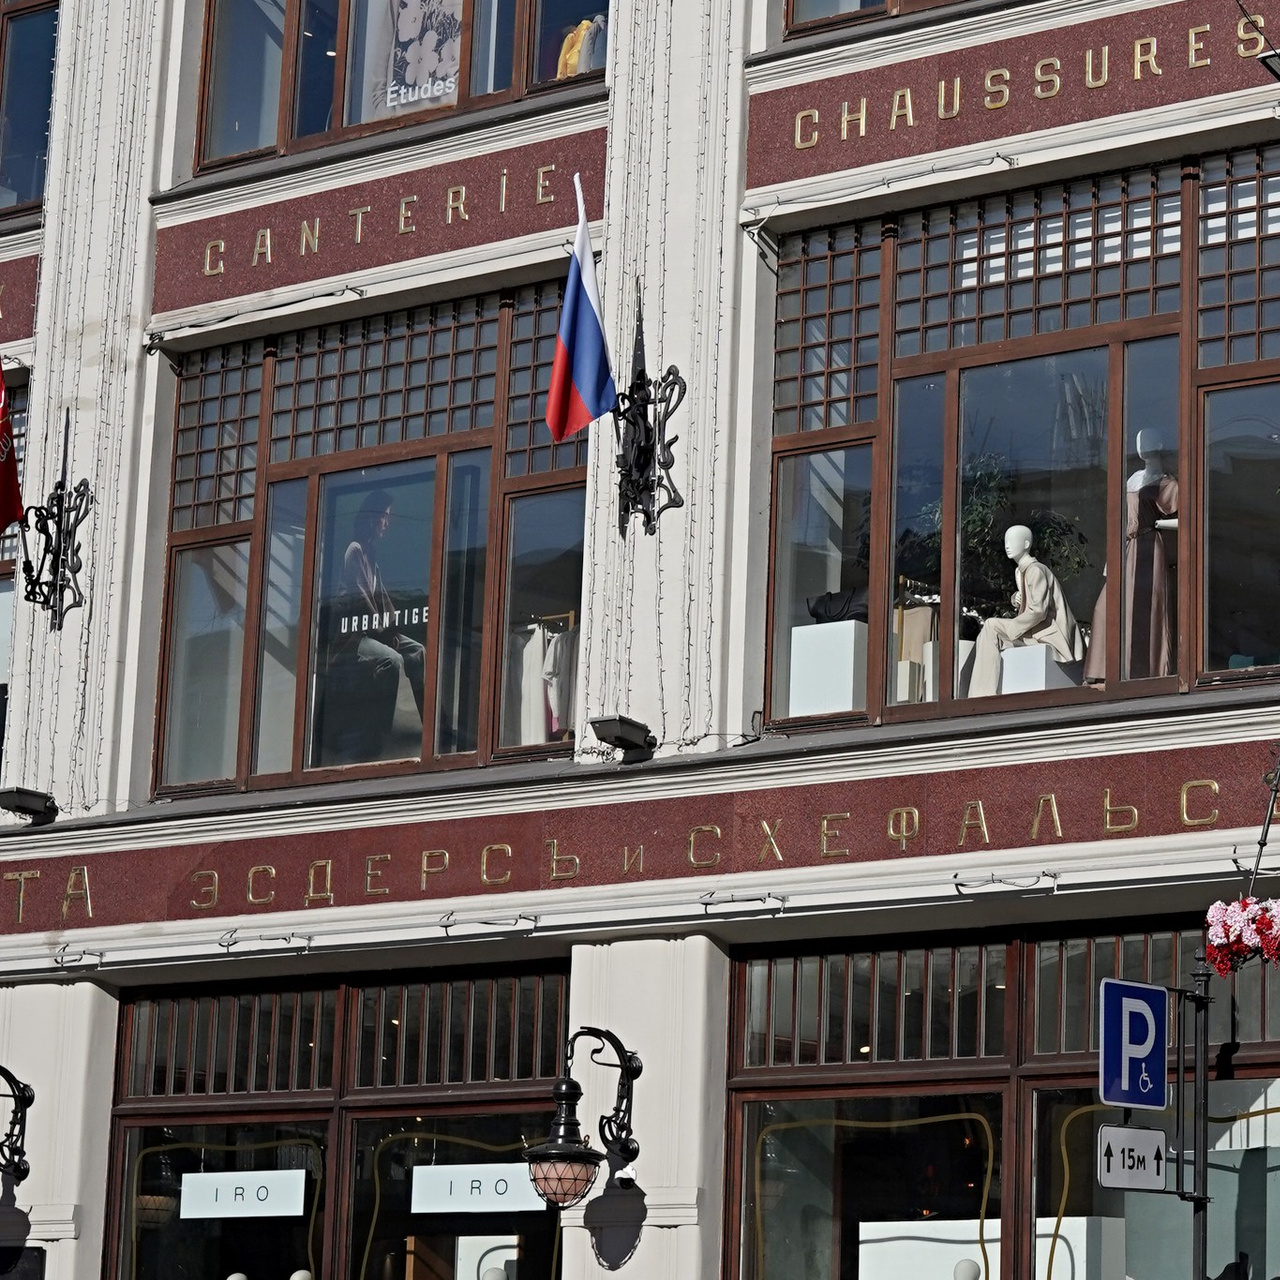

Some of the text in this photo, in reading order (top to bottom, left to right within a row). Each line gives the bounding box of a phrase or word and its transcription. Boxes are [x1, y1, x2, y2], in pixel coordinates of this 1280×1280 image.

[386, 77, 456, 107] Études
[795, 14, 1266, 149] CHAUSSURES
[190, 839, 580, 910] ЭСДЕРСЪ
[215, 1185, 269, 1203] IRO
[449, 1178, 509, 1197] IRO
